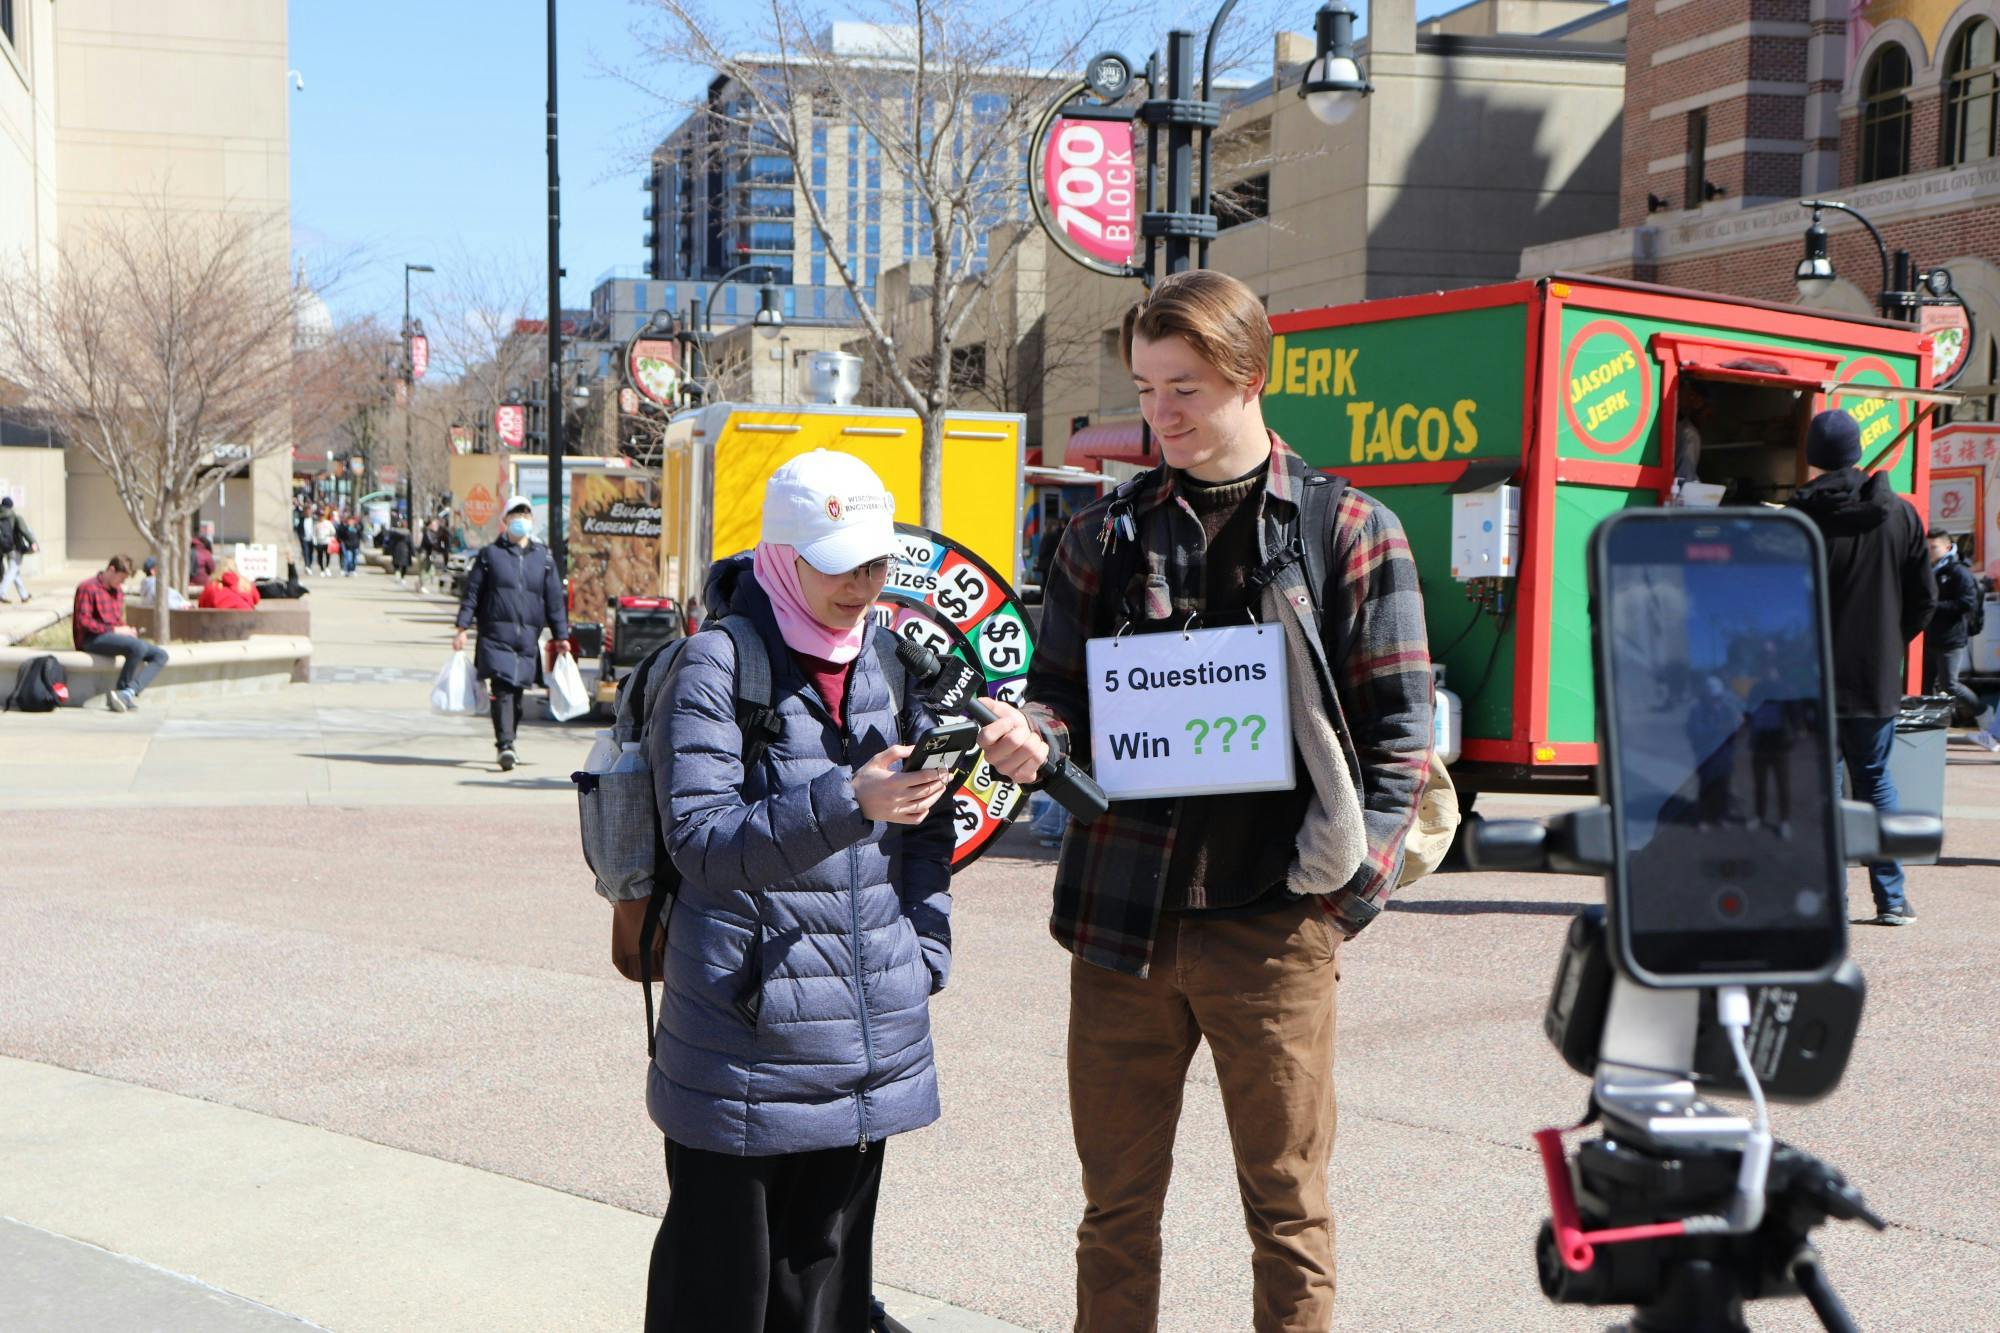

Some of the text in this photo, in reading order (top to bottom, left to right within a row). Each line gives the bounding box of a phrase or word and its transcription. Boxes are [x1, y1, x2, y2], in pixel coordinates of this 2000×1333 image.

[1057, 125, 1105, 239] 700
[1106, 149, 1132, 242] BLOCK
[1894, 184, 1917, 201] AND
[1923, 177, 1949, 196] WILL
[1951, 172, 1977, 192] GIVE
[1263, 334, 1359, 397] JERK
[1570, 350, 1636, 404] JASON'S
[499, 406, 514, 440] 700
[1346, 398, 1479, 464] TACOS
[1586, 389, 1630, 432] JERK
[1861, 414, 1893, 451] ERK
[583, 517, 635, 533] KOREAN
[905, 545, 931, 563] wo
[894, 567, 938, 591] izes
[937, 568, 985, 619] $5
[982, 621, 1021, 668] $5
[941, 666, 976, 709] Wyatt
[1105, 661, 1267, 693] 5 Questions
[1109, 714, 1267, 761] Win ???
